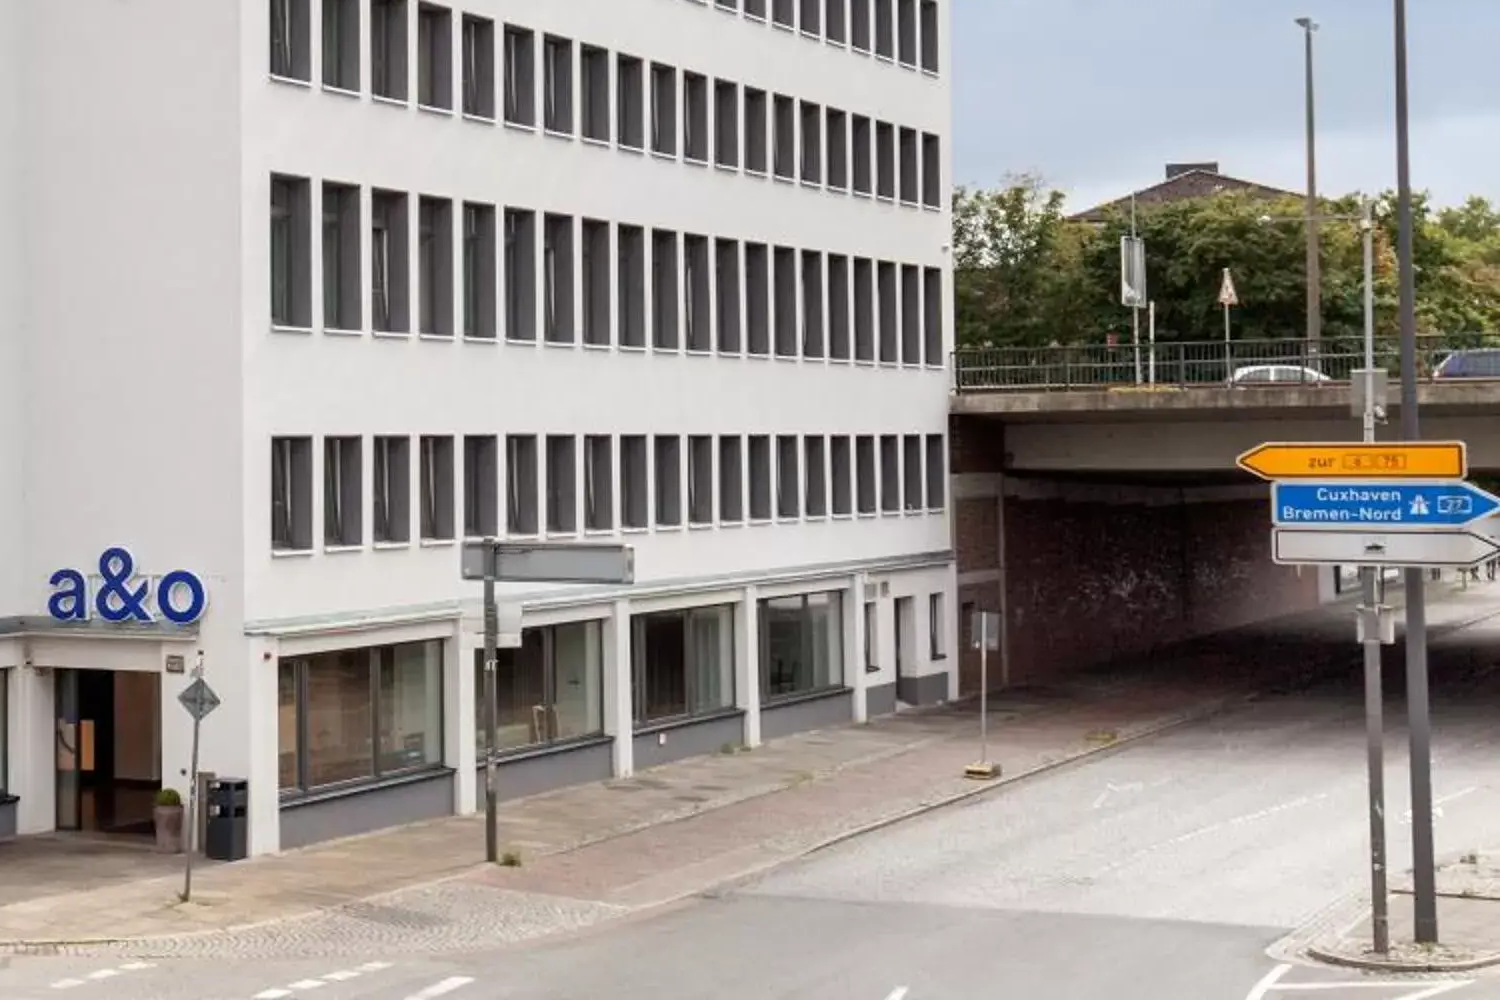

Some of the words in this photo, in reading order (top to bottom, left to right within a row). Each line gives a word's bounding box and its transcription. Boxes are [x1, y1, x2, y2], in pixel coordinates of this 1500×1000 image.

[1308, 457, 1336, 468] zur
[1316, 487, 1401, 501] Cuxhaven
[1283, 507, 1402, 521] Bremen-Nord
[47, 545, 208, 625] a&o
